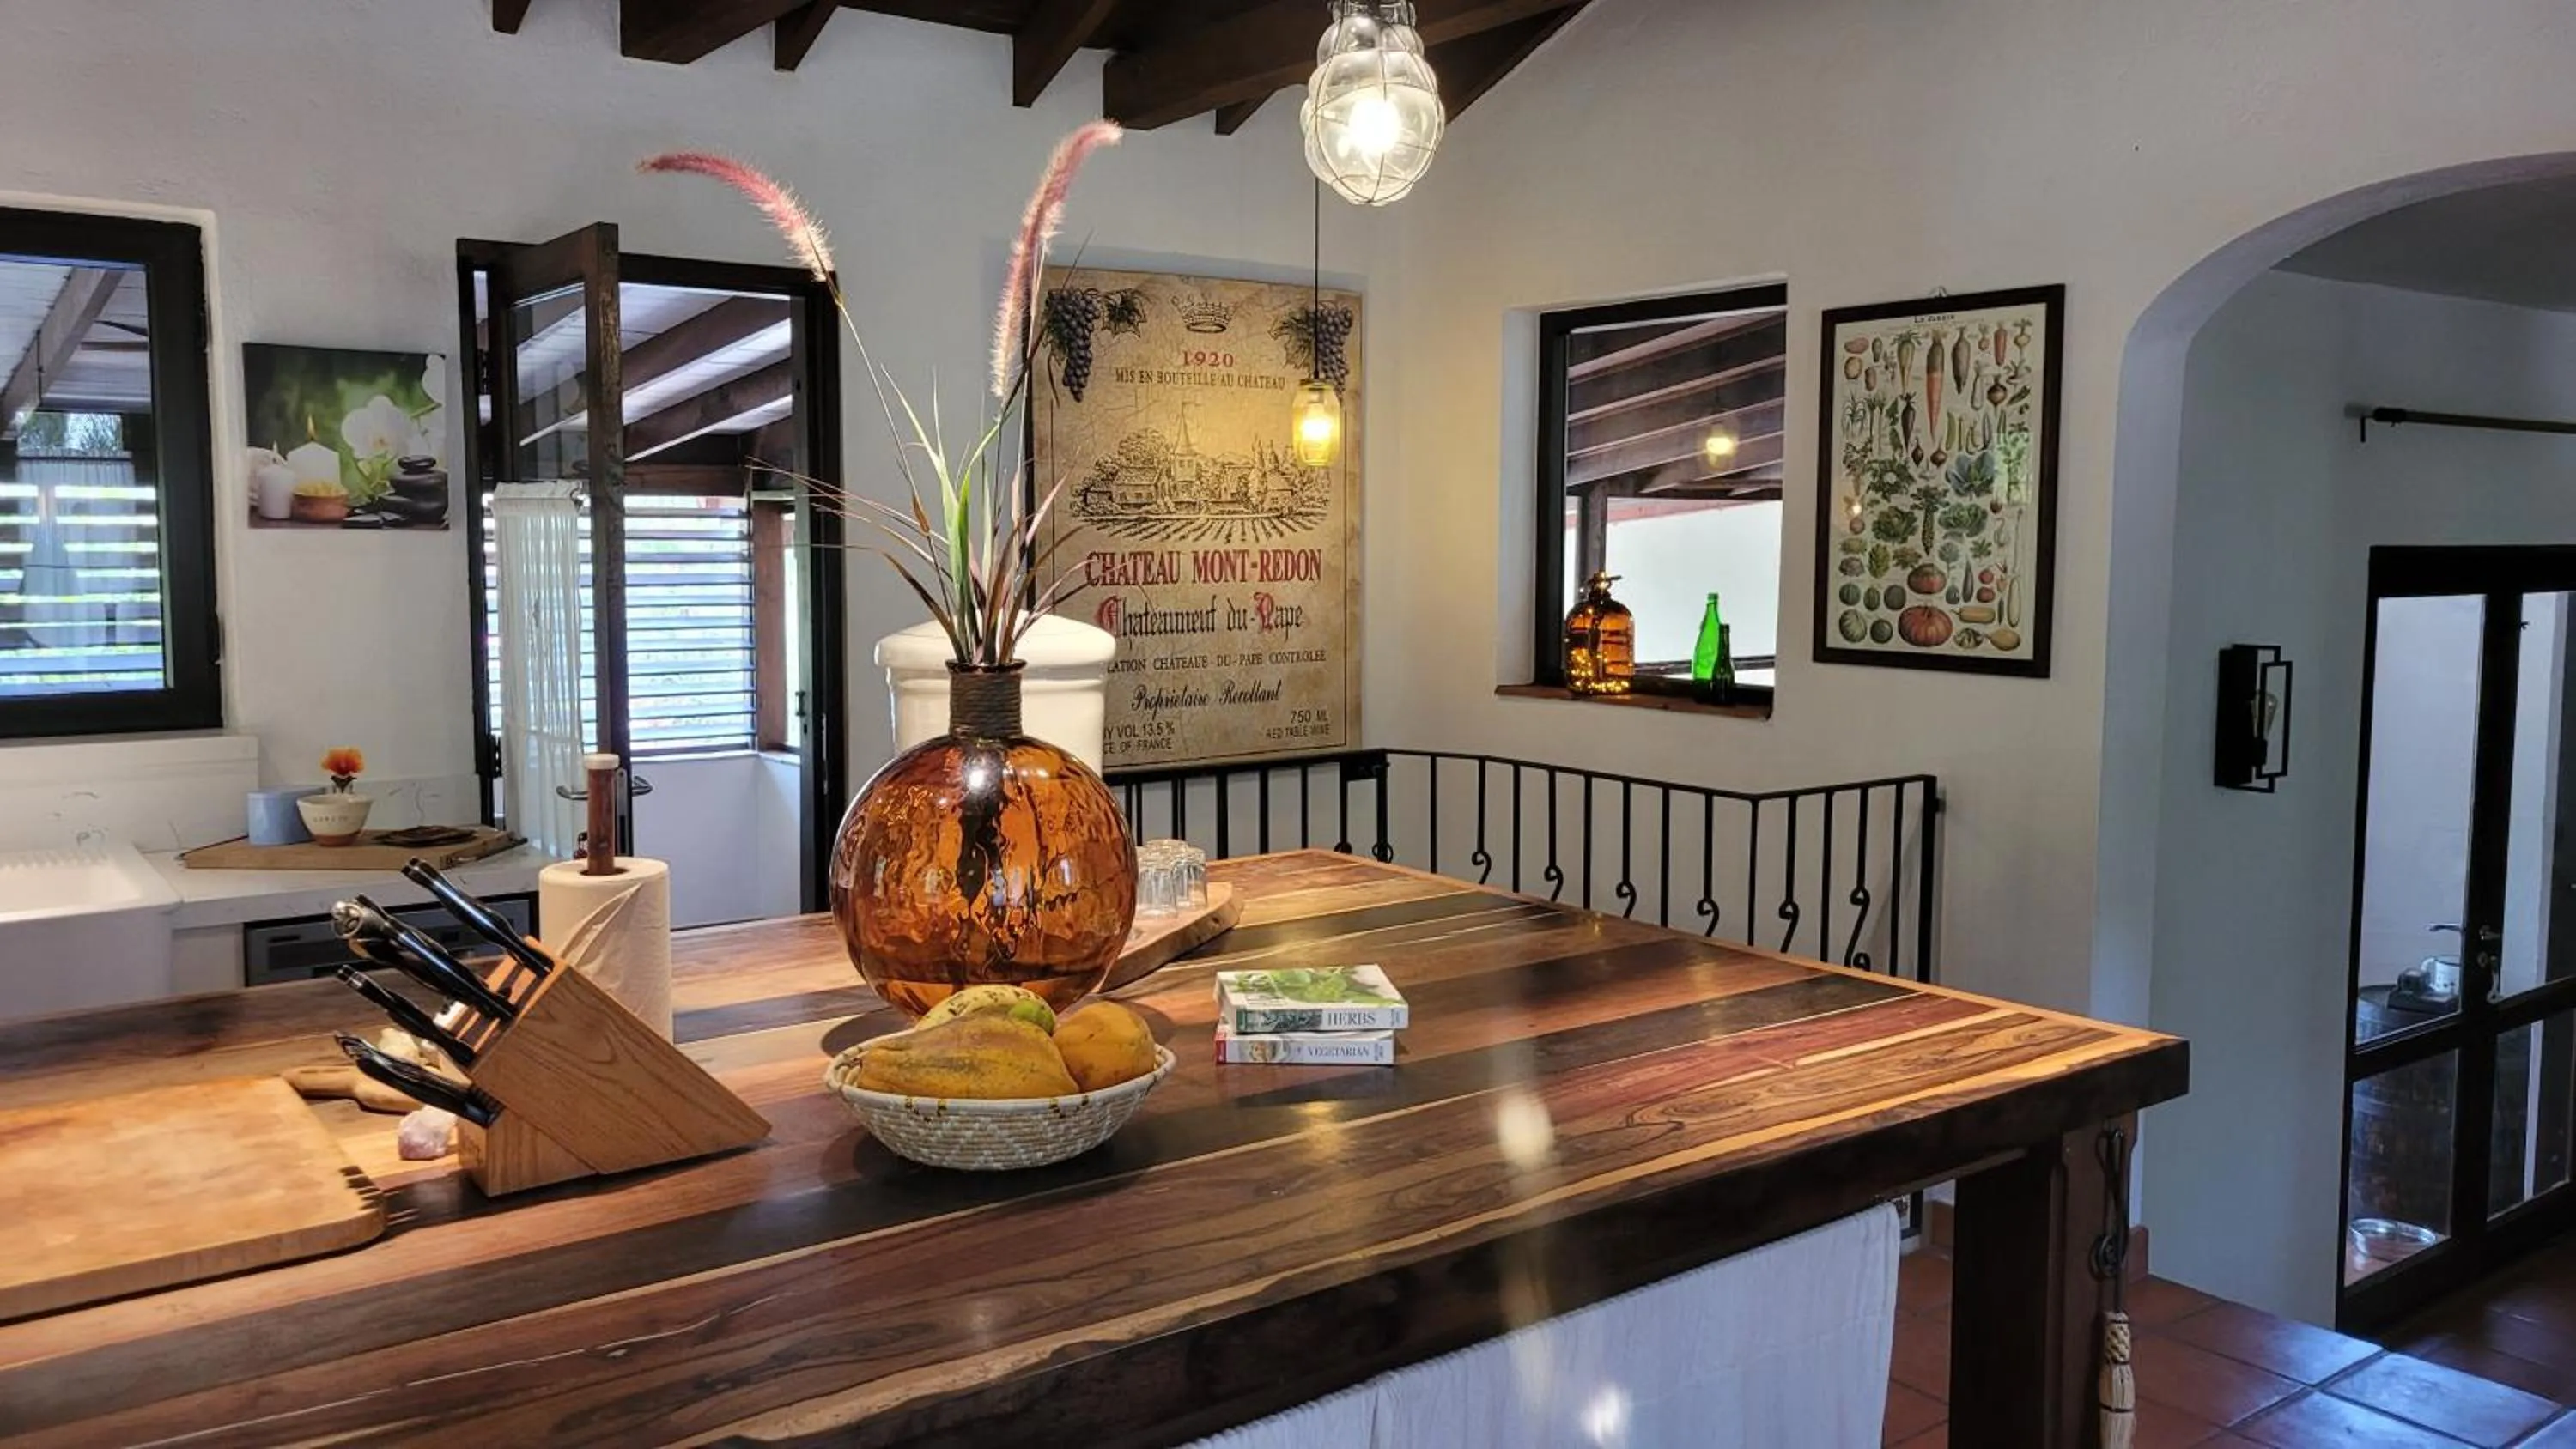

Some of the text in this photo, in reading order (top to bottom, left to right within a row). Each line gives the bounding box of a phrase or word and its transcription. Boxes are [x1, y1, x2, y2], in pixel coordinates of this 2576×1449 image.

[1182, 350, 1235, 367] 1920
[1115, 367, 1286, 390] MIS EN BOUTEILLE AU CHATEAU
[1085, 550, 1182, 587] CHATEAU
[1107, 658, 1147, 674] LATION
[1291, 709, 1312, 723] 750
[1117, 724, 1139, 738] VOL
[1119, 740, 1132, 753] OF
[1137, 737, 1173, 750] FRANCE
[1327, 1011, 1376, 1027] HERBS
[1307, 1045, 1371, 1058] VEGETARIAN
